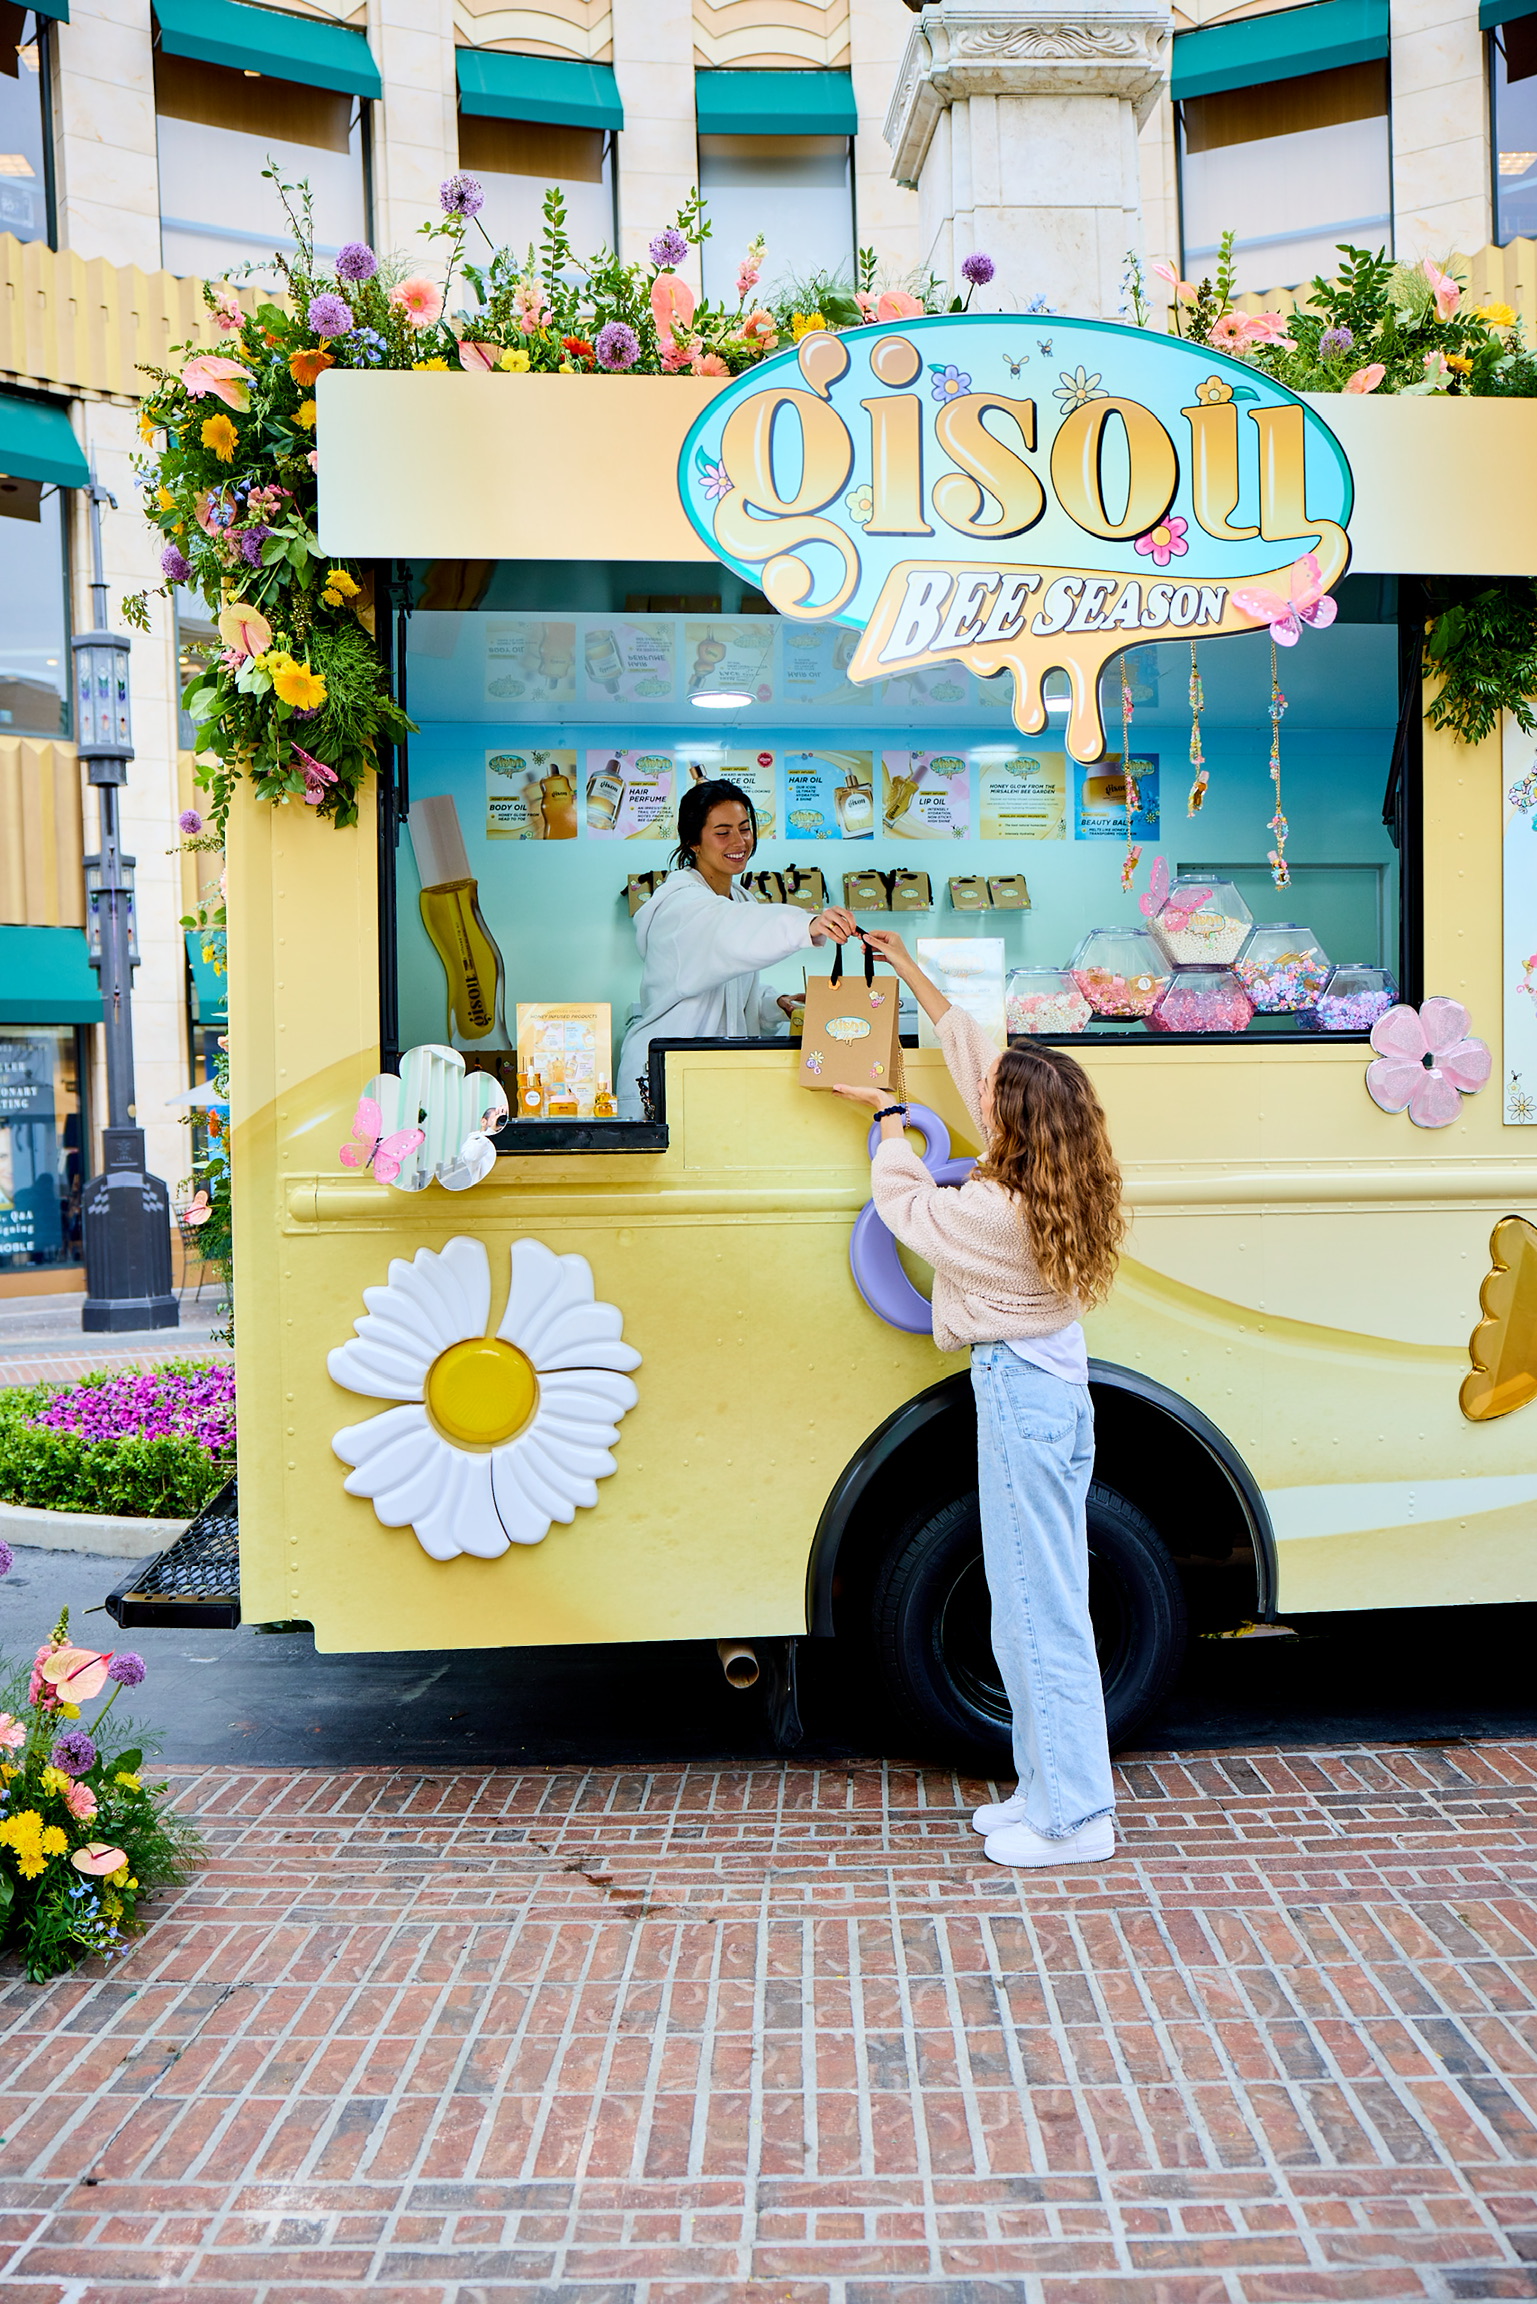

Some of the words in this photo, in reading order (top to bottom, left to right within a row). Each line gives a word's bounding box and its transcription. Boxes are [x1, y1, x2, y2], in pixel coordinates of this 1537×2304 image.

[713, 331, 1351, 619] gisou
[878, 570, 1041, 664] BEE
[1031, 576, 1229, 637] SEASON
[465, 976, 493, 1027] gisou
